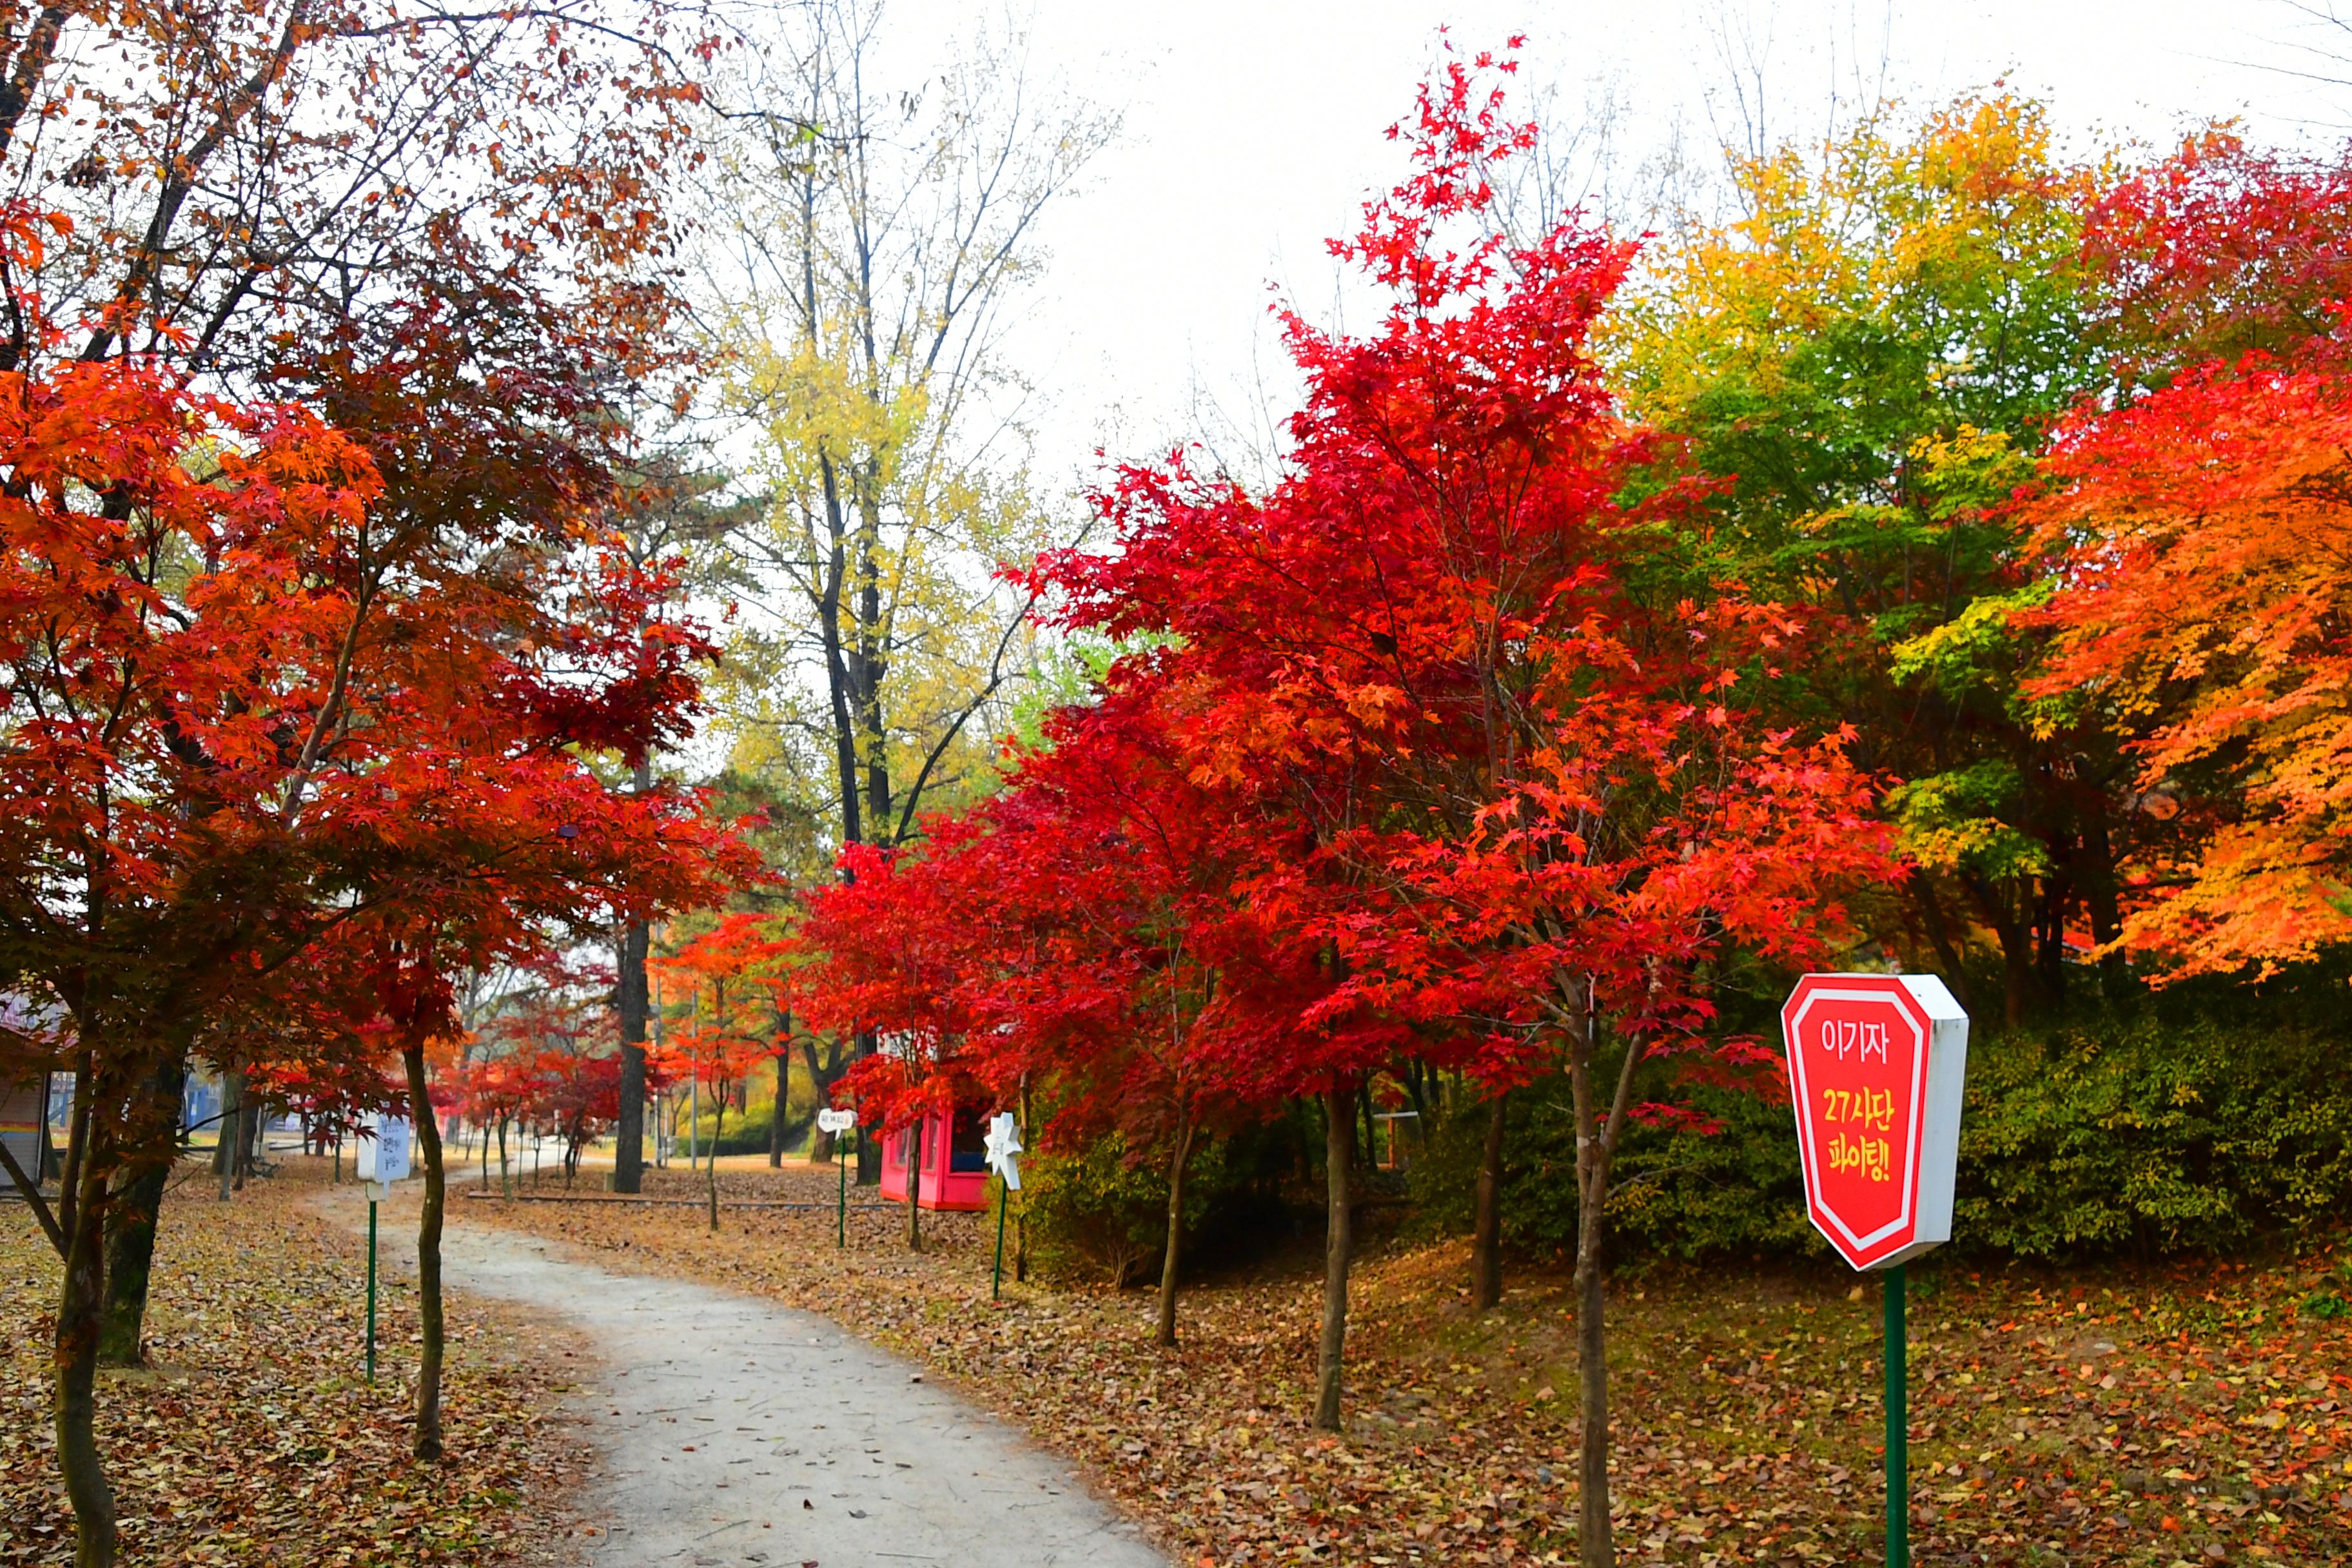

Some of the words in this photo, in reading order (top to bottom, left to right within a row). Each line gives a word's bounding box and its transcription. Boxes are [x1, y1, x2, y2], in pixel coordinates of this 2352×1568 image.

[1821, 1019, 1889, 1064] 이기자
[1823, 1086, 1894, 1131] 27사단
[1828, 1132, 1890, 1182] 파이팅!
